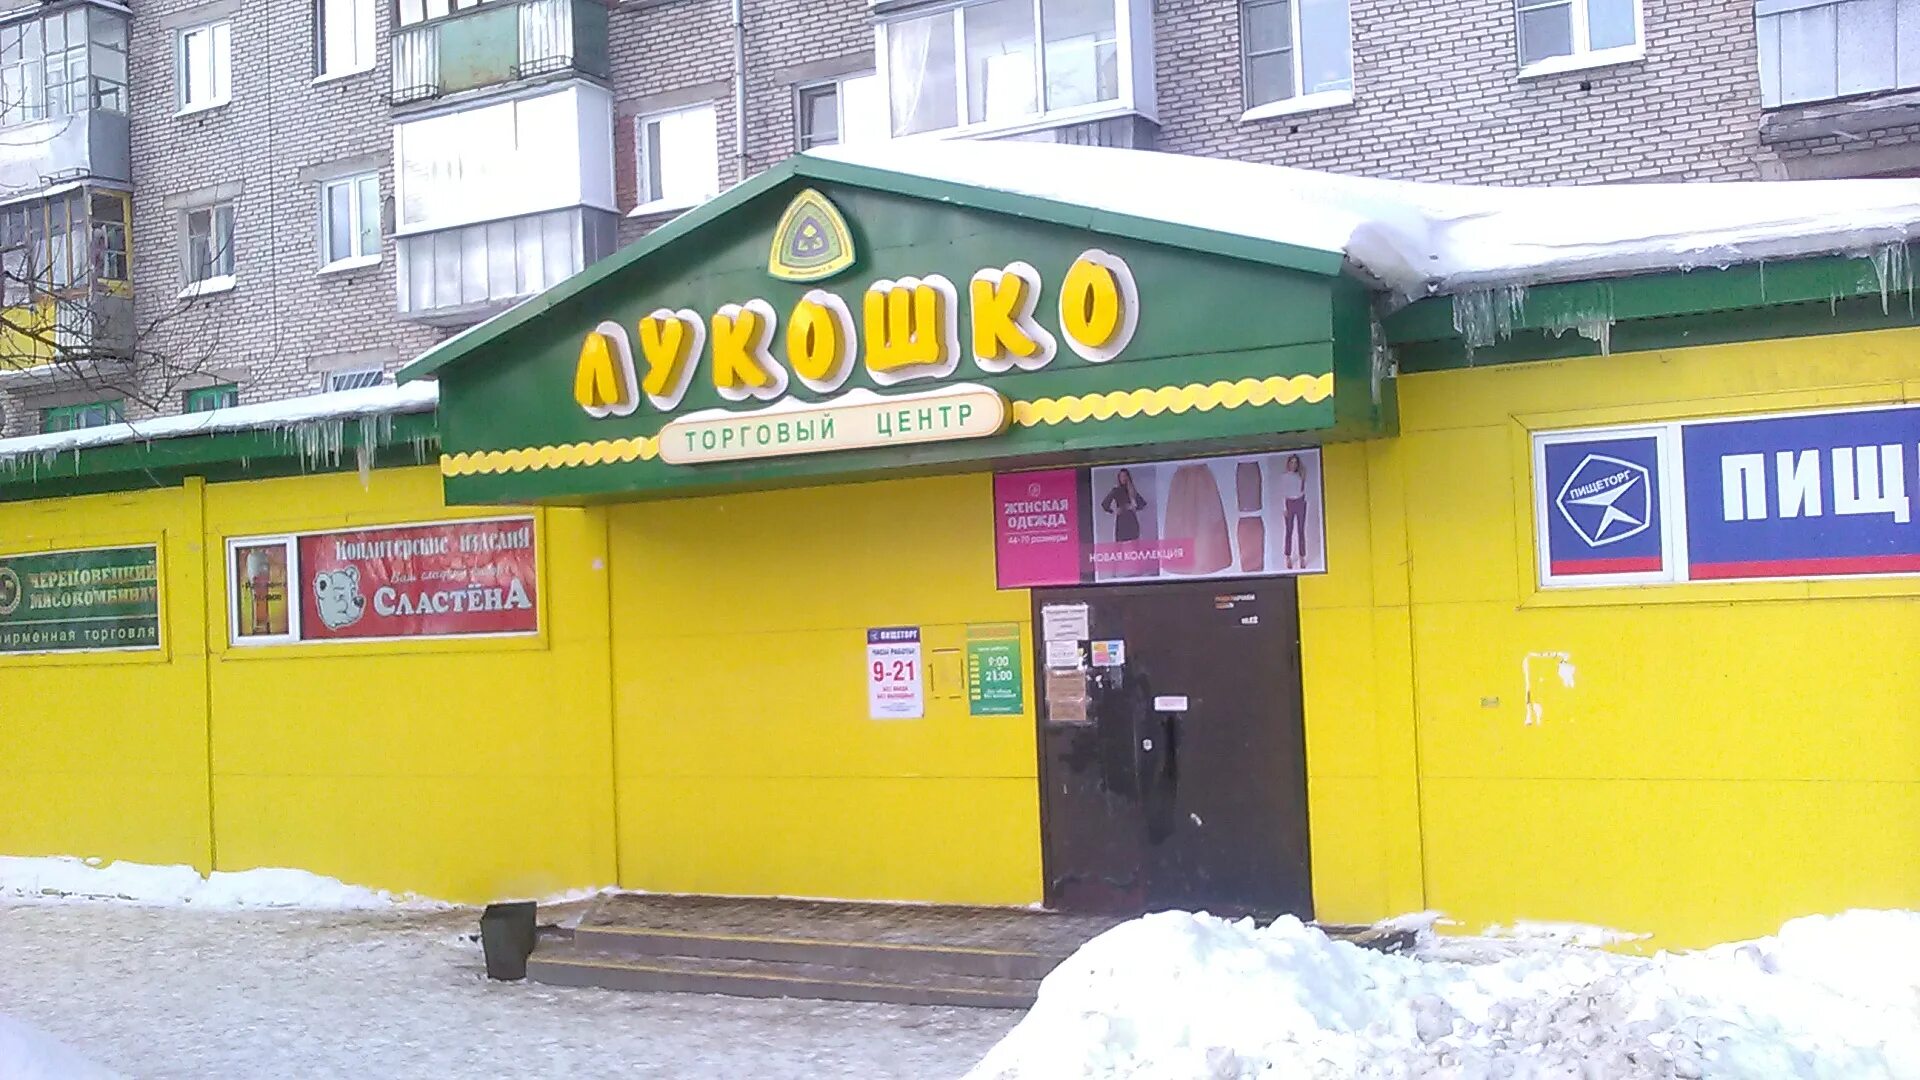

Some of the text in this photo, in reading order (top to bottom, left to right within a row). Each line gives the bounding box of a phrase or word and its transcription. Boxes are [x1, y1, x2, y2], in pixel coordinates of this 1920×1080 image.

[574, 249, 1139, 418] ЛУКОШКО
[685, 403, 974, 452] ТОРГОВЫЙ ЦЕНТР
[1569, 469, 1631, 499] ПИЩЕТОРГ
[1721, 443, 1920, 523] ПИЩ
[1004, 498, 1069, 515] ЖЕНСКАЯ
[1007, 512, 1067, 530] ОДЕЖДА
[335, 537, 448, 561] Кондитерские
[1089, 548, 1184, 563] НОВАЯ КОЛЛЕКЦИЯ
[28, 560, 156, 588] ЧЕРЕПОВЕЦКИЙ
[0, 626, 156, 646] ирменная торговля
[873, 661, 914, 682] 9-21
